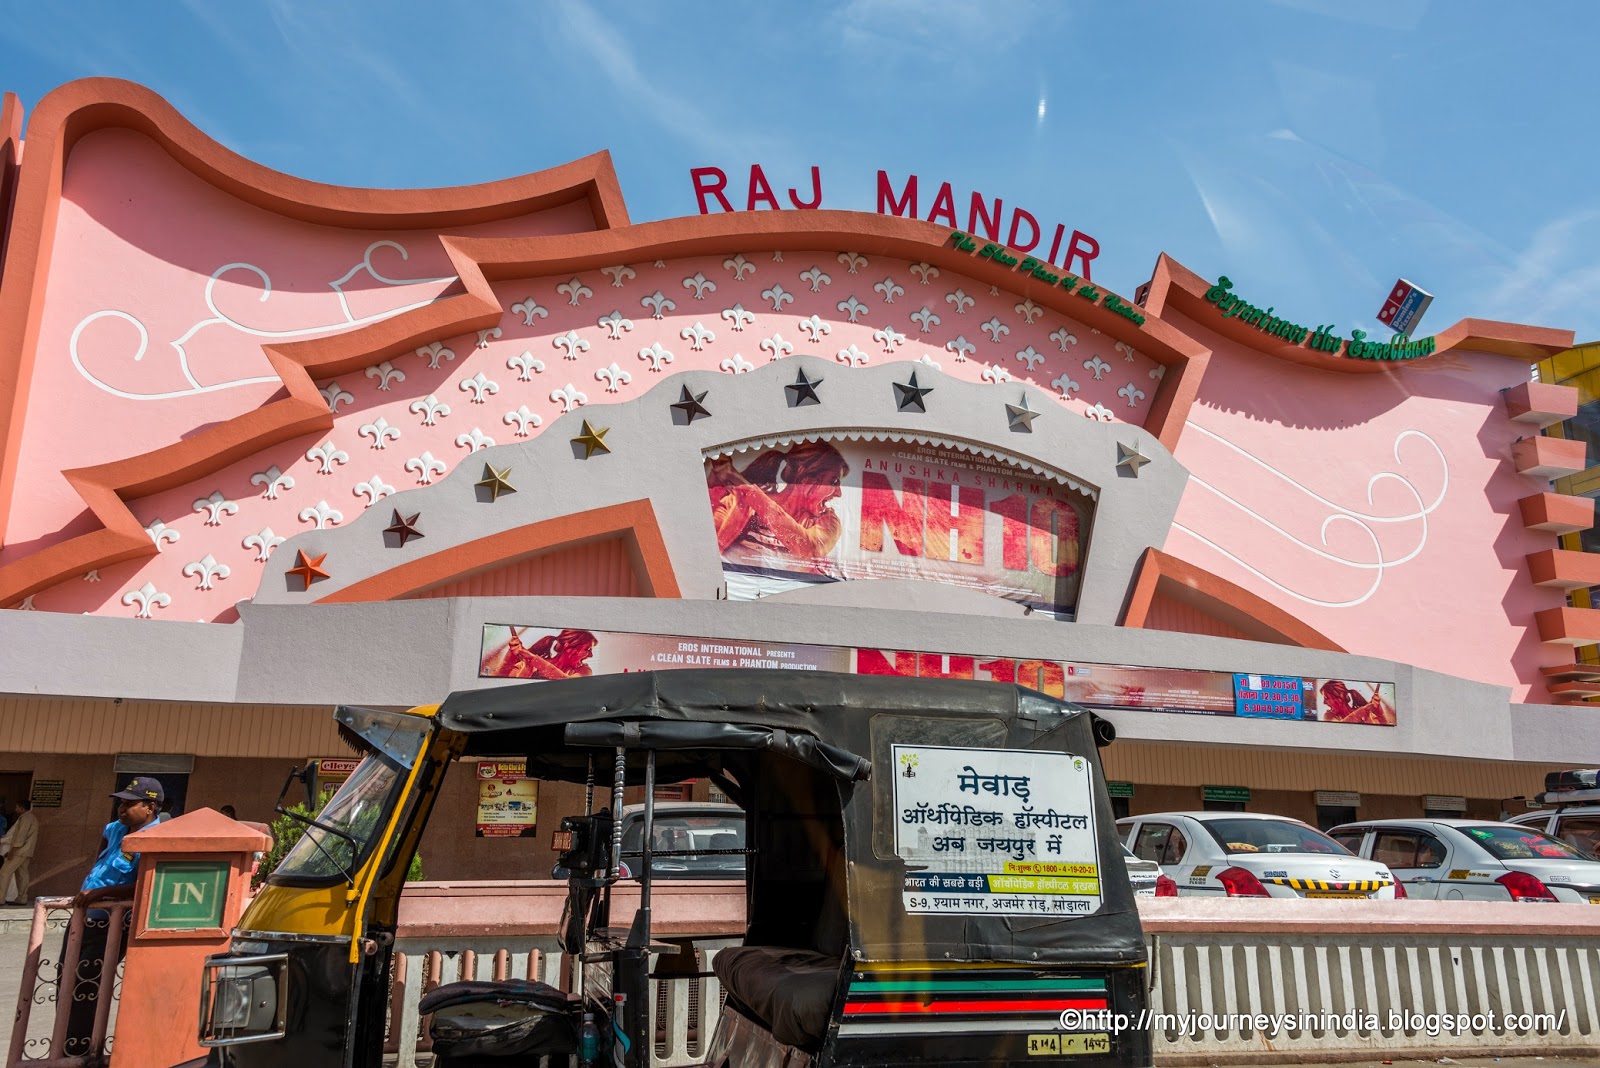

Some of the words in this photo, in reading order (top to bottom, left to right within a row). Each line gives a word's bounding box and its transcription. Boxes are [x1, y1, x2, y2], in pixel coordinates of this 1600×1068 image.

[690, 163, 823, 216] RAJ
[876, 169, 1101, 282] MANDIR
[951, 231, 976, 252] The
[979, 243, 1018, 267] Show
[1020, 257, 1059, 285] Place
[1061, 275, 1079, 290] of
[1078, 284, 1100, 301] the
[1104, 294, 1146, 326] Nation
[1205, 275, 1308, 344] Experience
[1311, 324, 1343, 354] the
[1348, 329, 1437, 361] Excellence
[1393, 292, 1417, 327] Domino's
[1398, 310, 1414, 331] Pizza
[898, 451, 923, 463] CLEAN
[925, 456, 949, 466] SLATE
[950, 461, 967, 469] FILMS
[976, 464, 1013, 476] PHANTOM
[1014, 471, 1047, 482] PRODUCTIO
[917, 446, 937, 456] EROS
[938, 451, 997, 466] INTERNATIONAL
[864, 458, 960, 484] ANUSHKA
[975, 475, 1054, 498] SHARMA
[860, 471, 1079, 577] NH10
[657, 652, 684, 664] CLEAN
[686, 654, 711, 666] SLATE
[713, 659, 730, 667] FILMS
[739, 658, 779, 669] PHANTOM
[678, 642, 699, 653] EROS
[700, 644, 762, 657] INTERNATIONAL
[766, 650, 796, 659] PRESENTS
[957, 766, 1031, 803] मेवाड़
[901, 802, 1003, 826] ऑर्थोपेडिक
[1013, 805, 1088, 830] हॉस्पीटल
[932, 836, 966, 851] अब
[976, 837, 1036, 861] जयपुर
[1046, 834, 1063, 855] में
[904, 877, 927, 888] भारत
[928, 875, 940, 888] की
[942, 876, 965, 888] सबसे
[1043, 865, 1057, 873] 1800
[169, 882, 208, 905] IN
[910, 897, 931, 910] S-9,
[933, 897, 961, 909] श्याम
[962, 898, 989, 911] नगर,
[992, 895, 1025, 910] अजमेर
